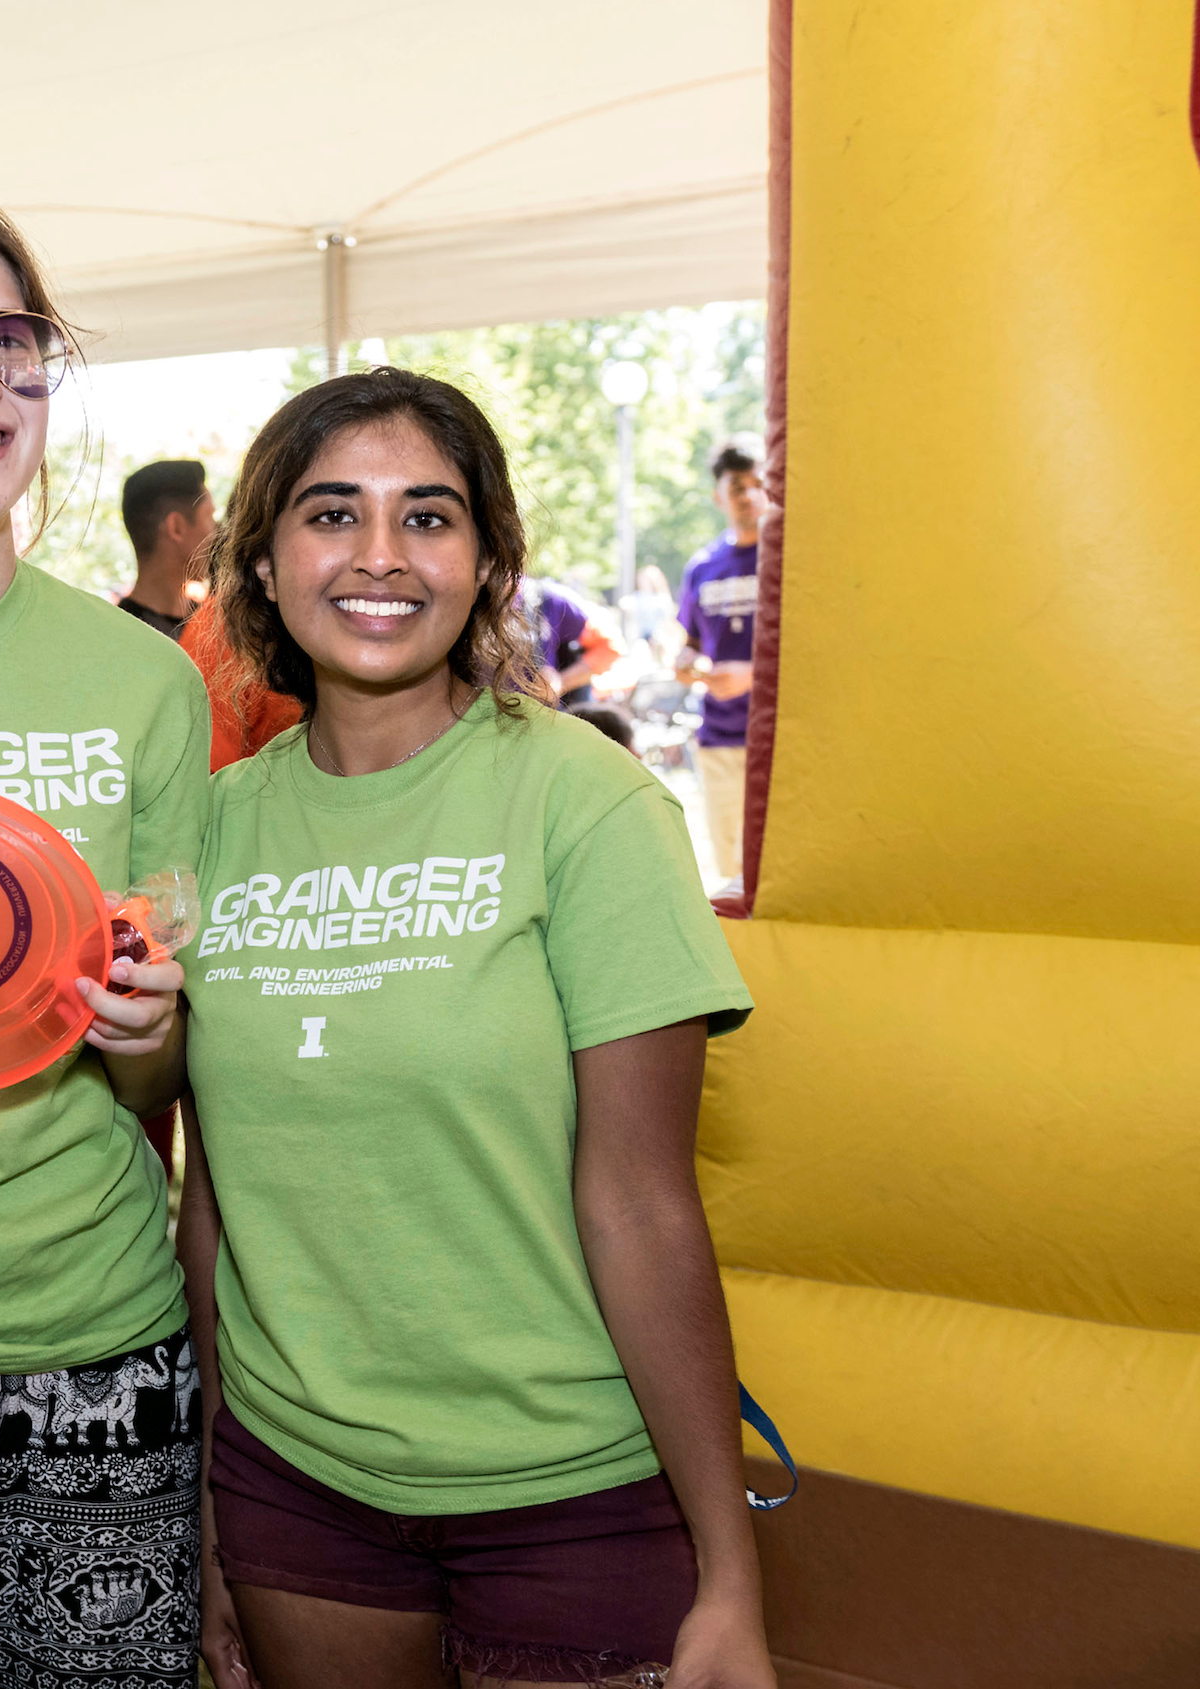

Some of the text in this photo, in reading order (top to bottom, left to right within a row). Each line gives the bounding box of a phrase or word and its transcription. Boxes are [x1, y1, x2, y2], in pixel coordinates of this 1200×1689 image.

[210, 853, 506, 925] GRAINGER
[197, 896, 501, 959] ENGINEERING
[205, 955, 454, 983] CIVIL AND ENVIRONMENTAL
[260, 976, 383, 996] ENGINEERING
